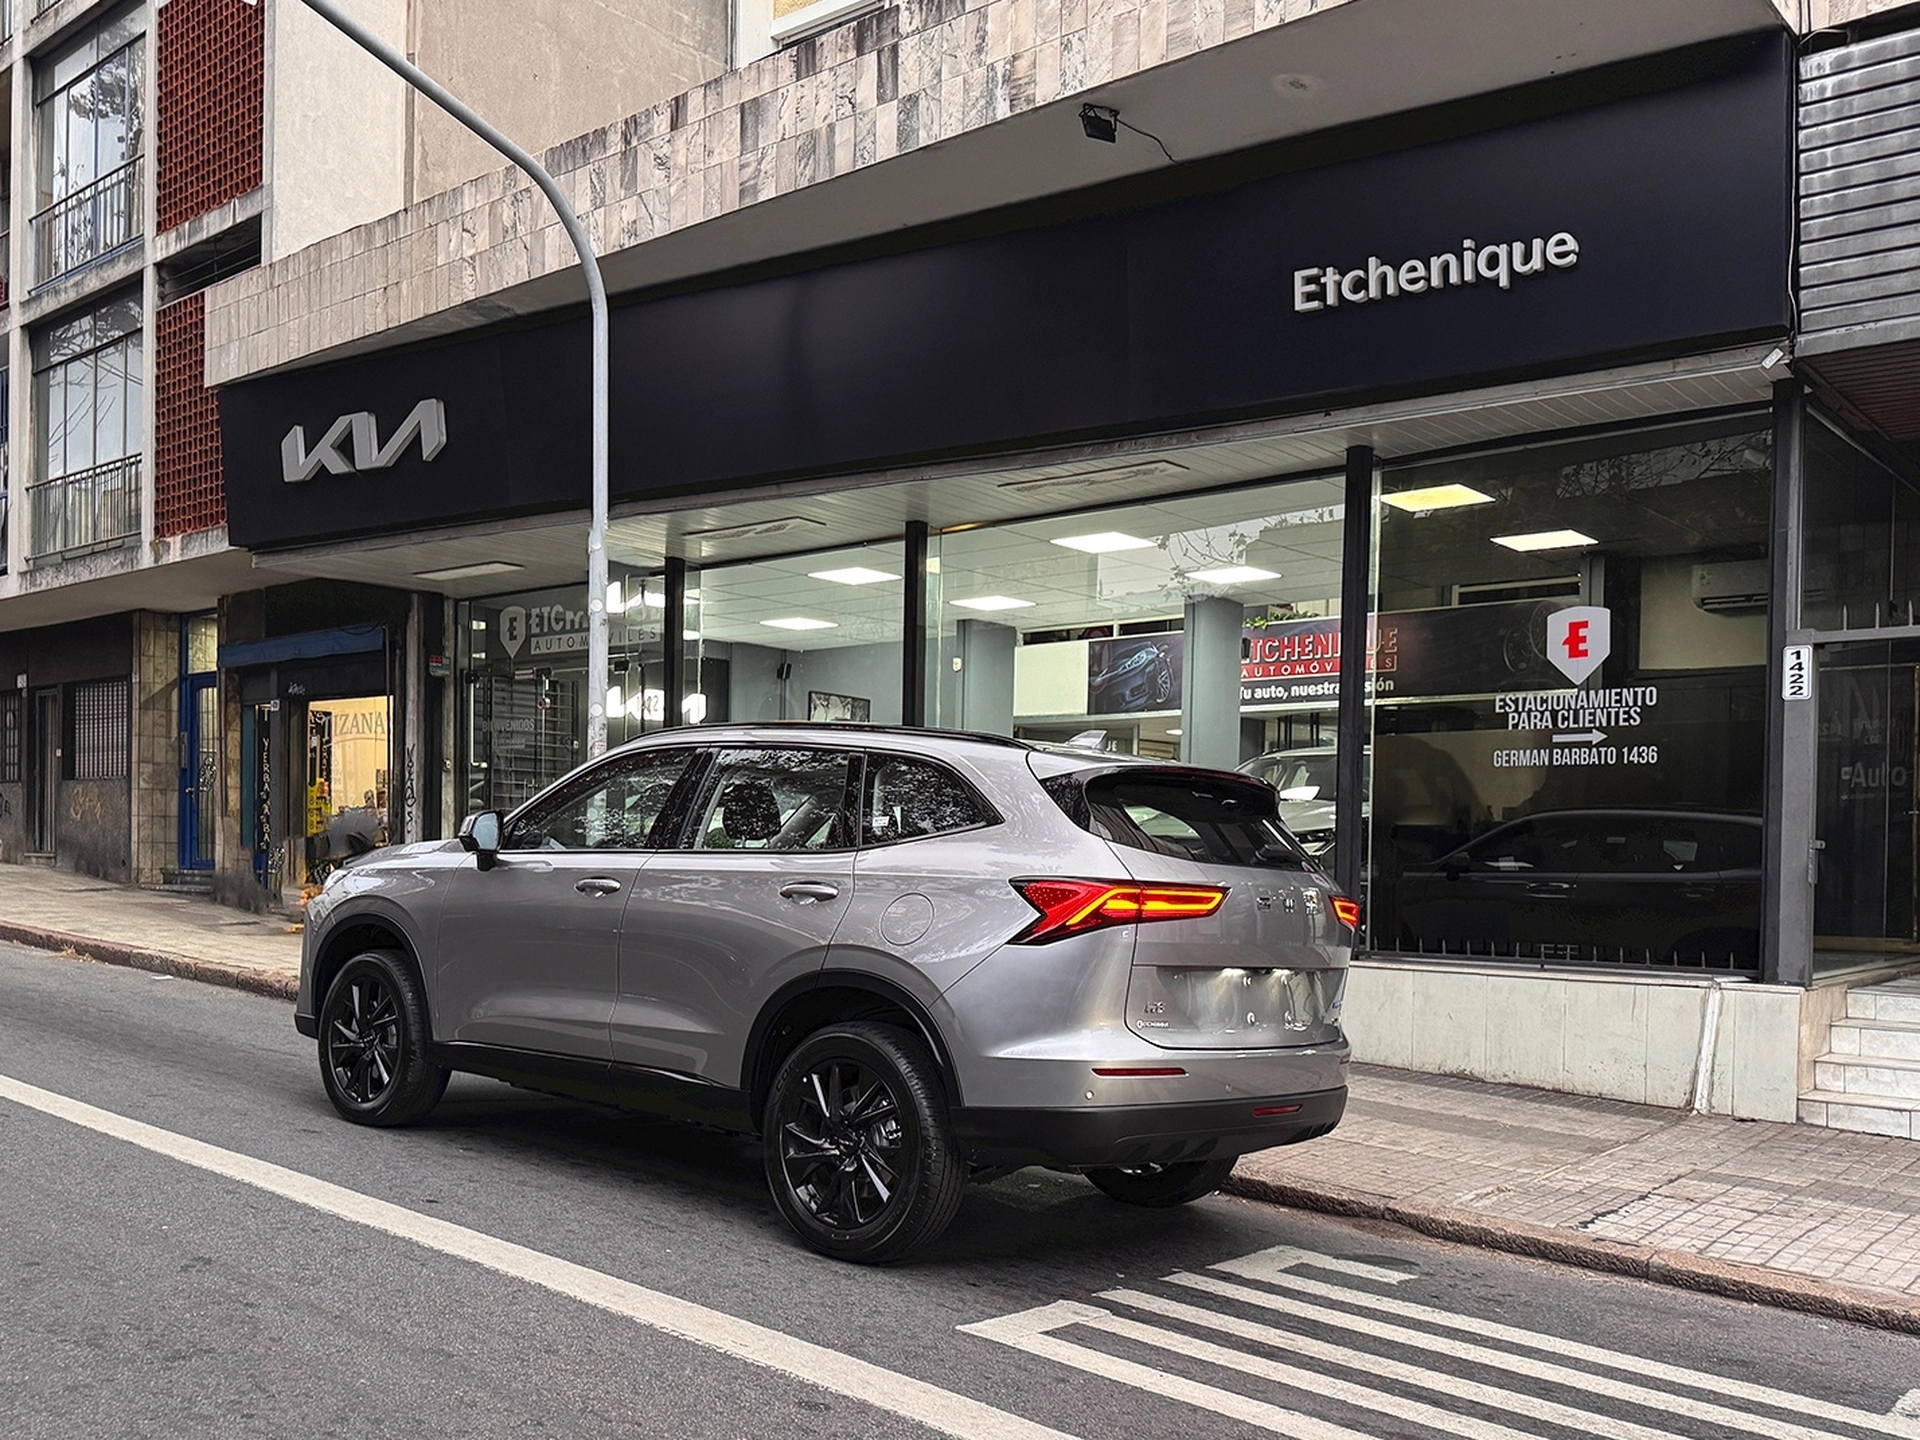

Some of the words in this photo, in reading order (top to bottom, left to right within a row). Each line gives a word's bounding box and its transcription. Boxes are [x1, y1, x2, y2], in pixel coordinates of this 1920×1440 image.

[1294, 231, 1579, 312] Etchenique
[281, 397, 447, 482] KIA
[533, 627, 656, 652] AUTOMVILES
[1561, 620, 1589, 659] E
[1240, 658, 1392, 678] AUTOMÓVES
[1788, 649, 1804, 696] 1422
[1254, 683, 1288, 699] auto,
[1495, 686, 1657, 713] ESTACIONAMIENTO
[1508, 710, 1552, 731] PARA
[1557, 706, 1641, 729] CLIENTES
[1493, 750, 1549, 768] GERMAN
[1553, 747, 1616, 766] BARBATO
[1622, 746, 1658, 764] 1436
